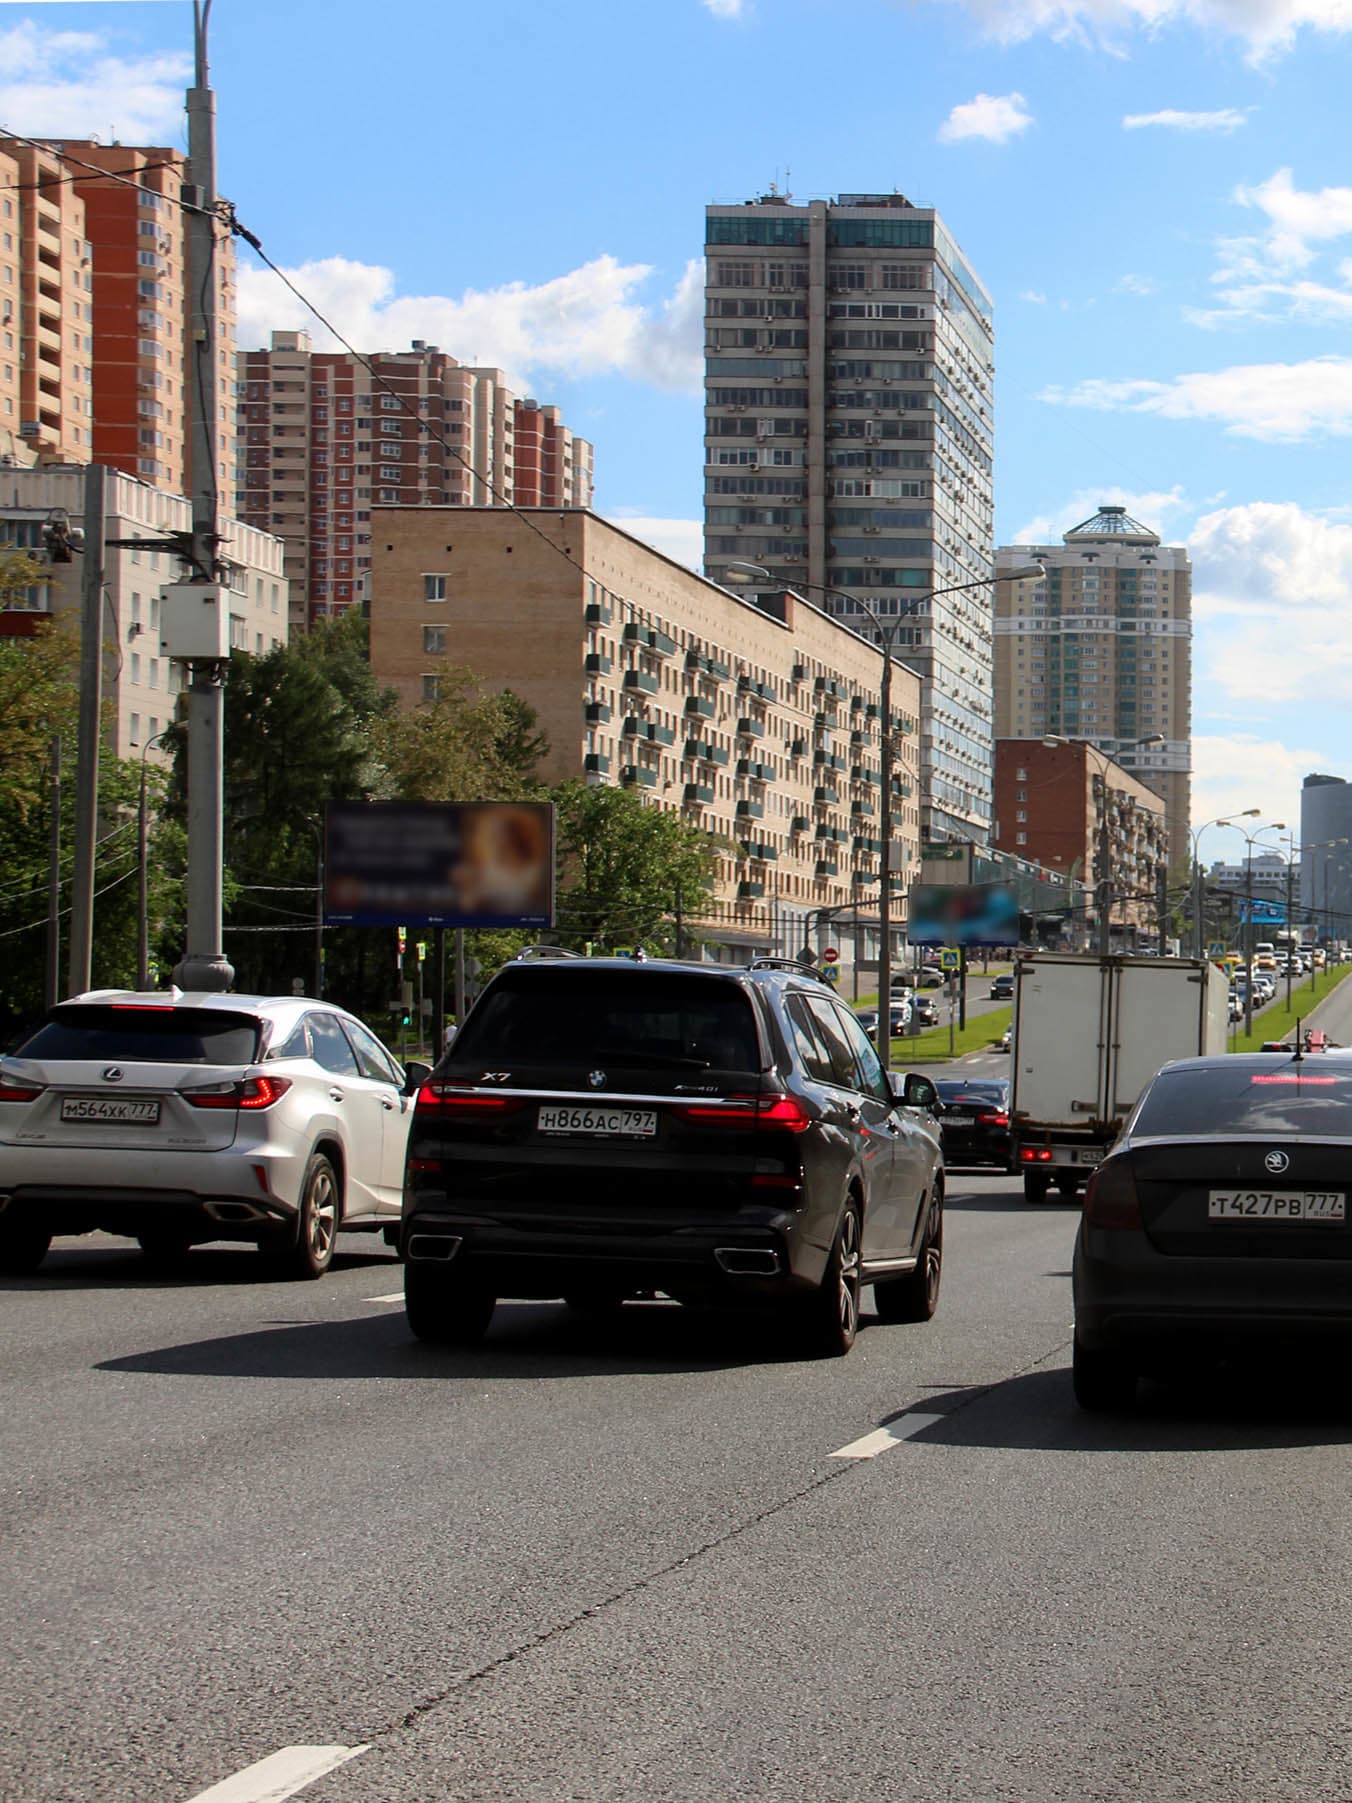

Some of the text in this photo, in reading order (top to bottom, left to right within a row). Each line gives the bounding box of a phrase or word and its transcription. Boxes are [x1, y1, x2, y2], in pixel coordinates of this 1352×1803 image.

[480, 1072, 512, 1082] X7
[131, 1103, 154, 1115] 777
[544, 1110, 653, 1131] Н866АС 797
[1216, 1193, 1340, 1216] Т427РВ 777
